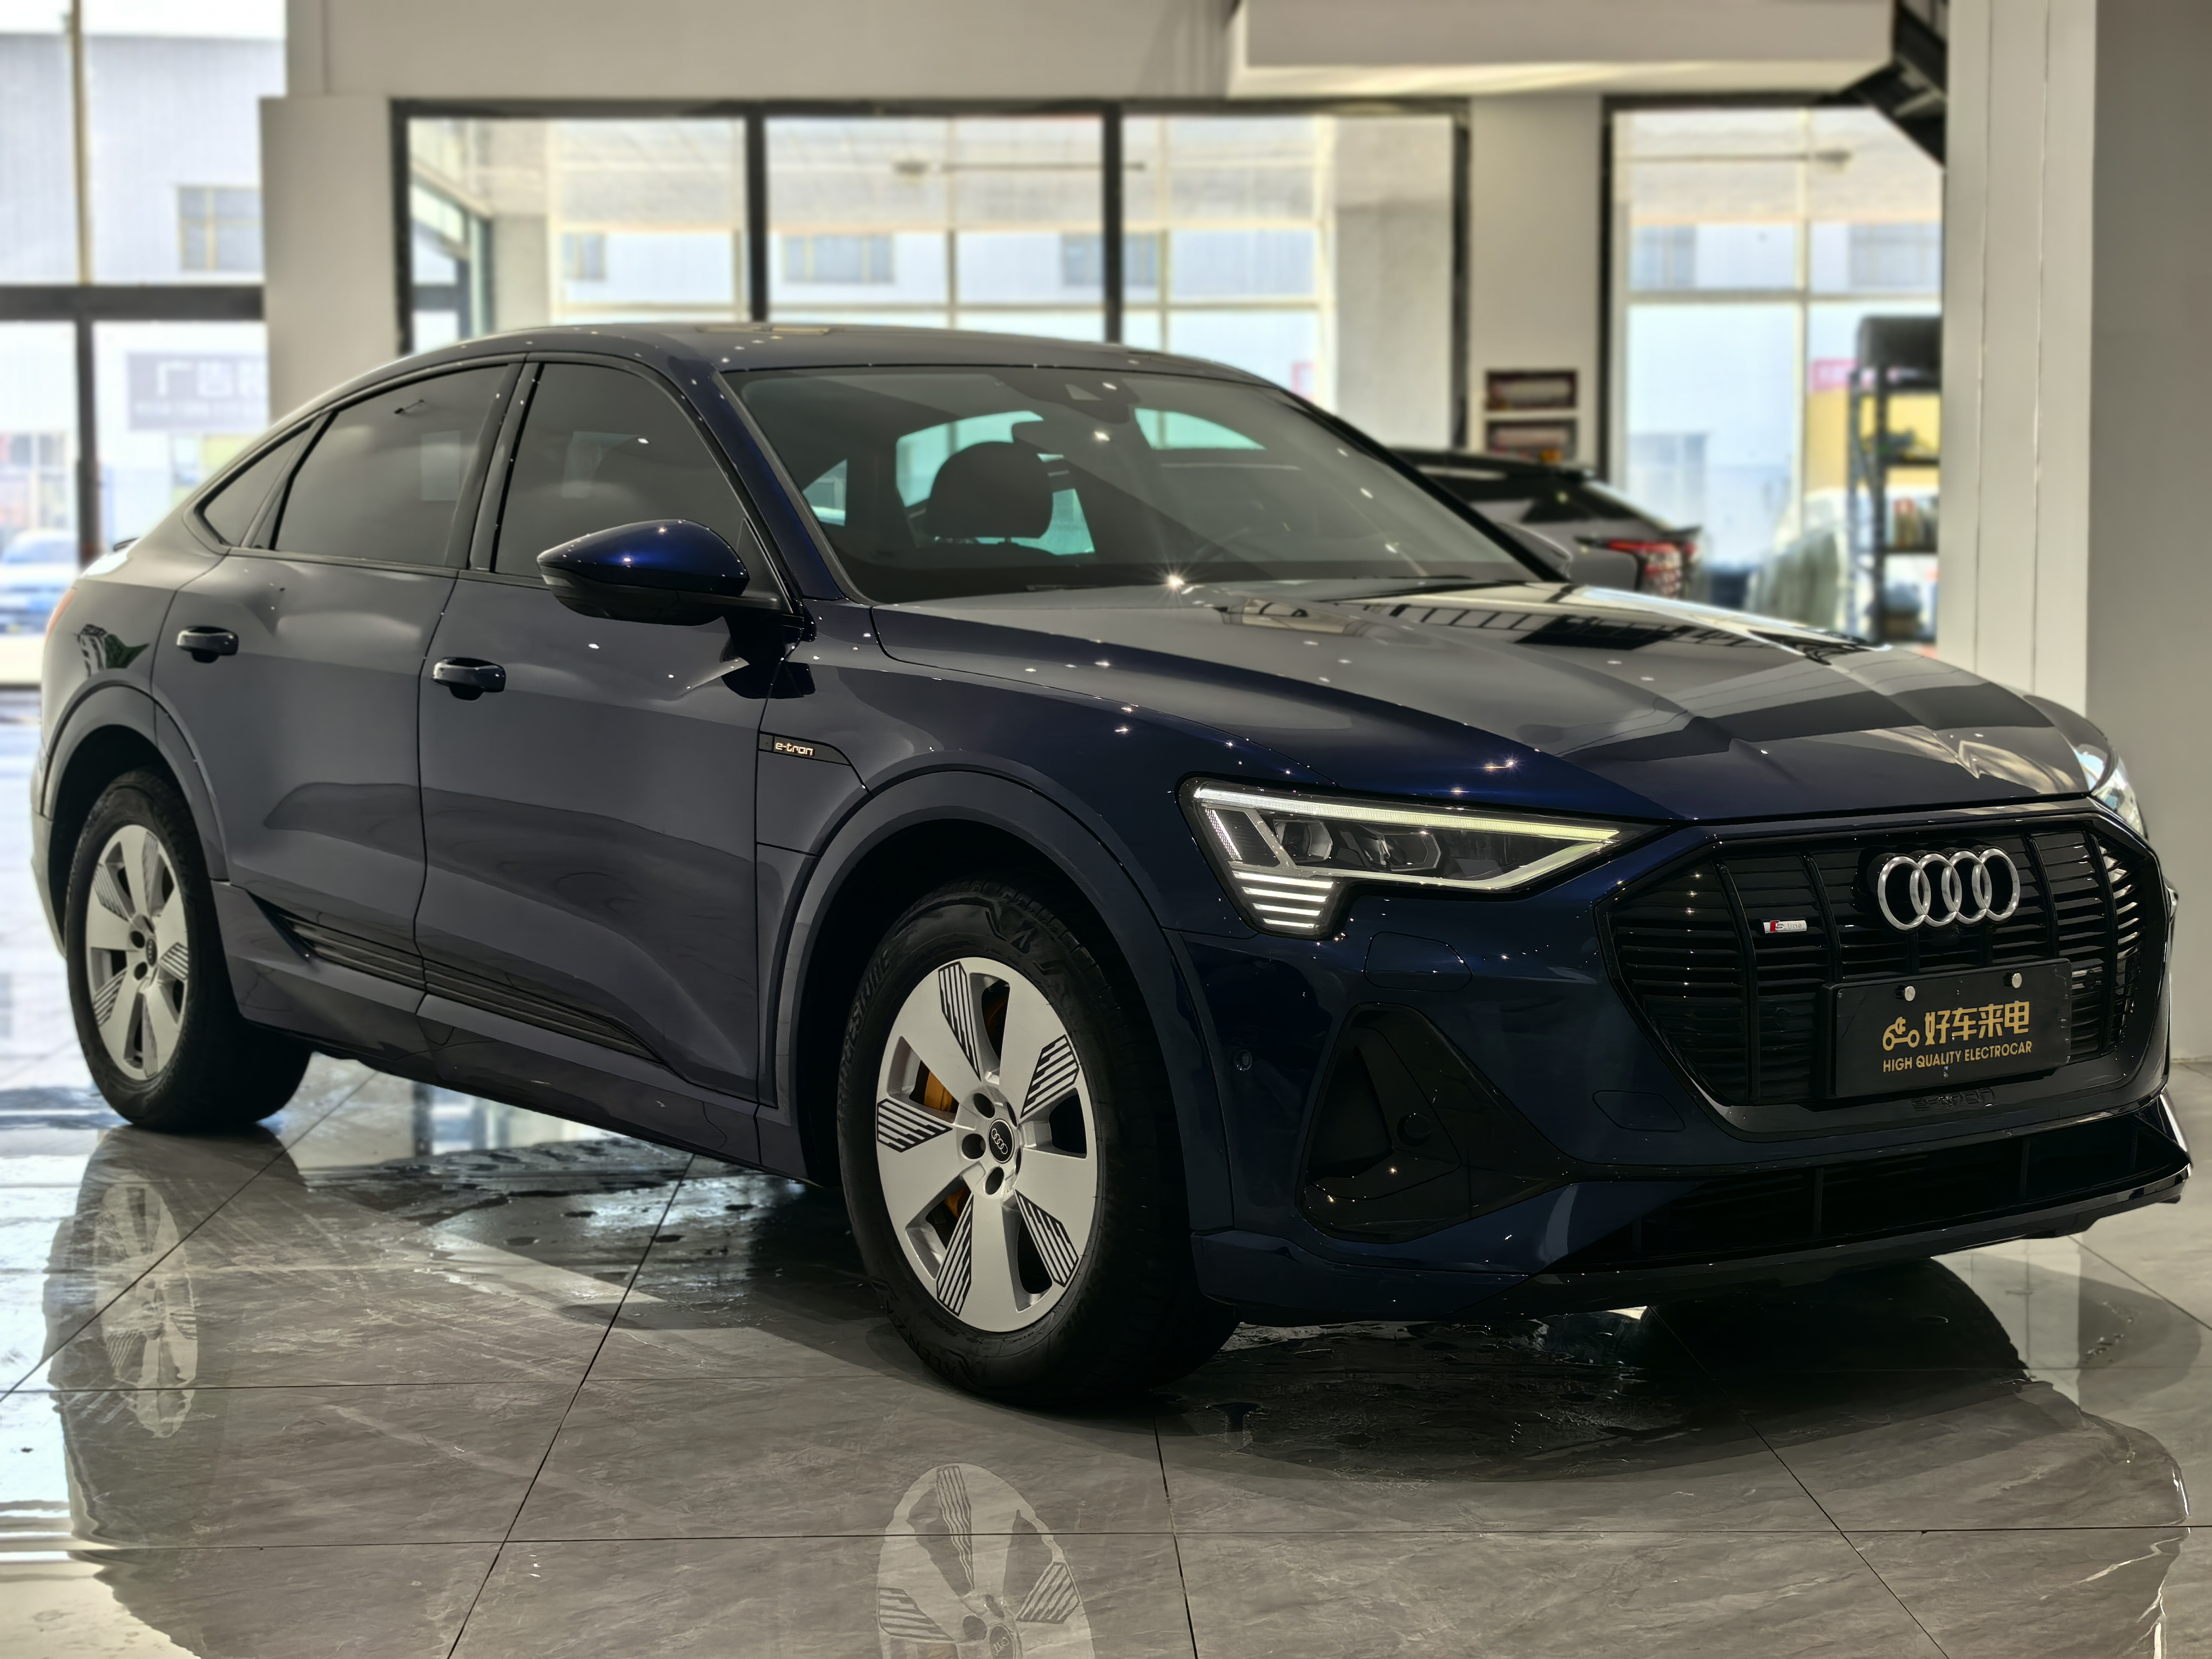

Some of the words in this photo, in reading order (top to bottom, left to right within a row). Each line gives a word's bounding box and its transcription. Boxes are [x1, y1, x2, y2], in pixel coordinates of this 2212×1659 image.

[775, 742, 813, 756] e-tron
[1925, 1000, 2029, 1046] 好车来电
[1883, 1057, 1912, 1073] HIGH
[1916, 1050, 1961, 1068] QUALITY
[1965, 1041, 2032, 1062] ELECTROCAR
